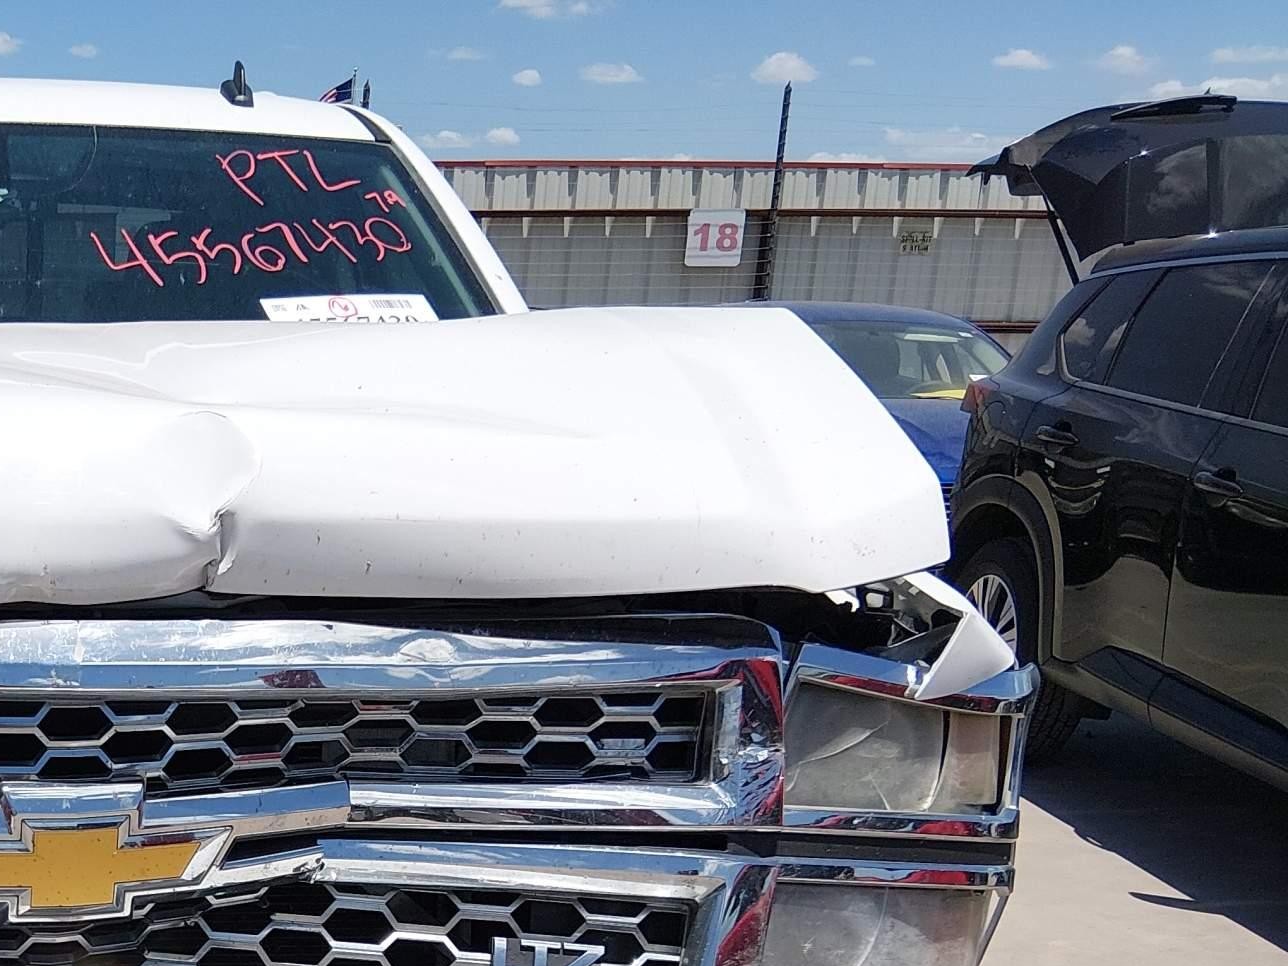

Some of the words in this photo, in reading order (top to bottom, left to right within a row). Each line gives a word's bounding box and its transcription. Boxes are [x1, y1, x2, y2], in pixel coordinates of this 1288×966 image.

[216, 149, 362, 207] PTL
[90, 216, 413, 287] 45567430
[693, 222, 739, 252] 18
